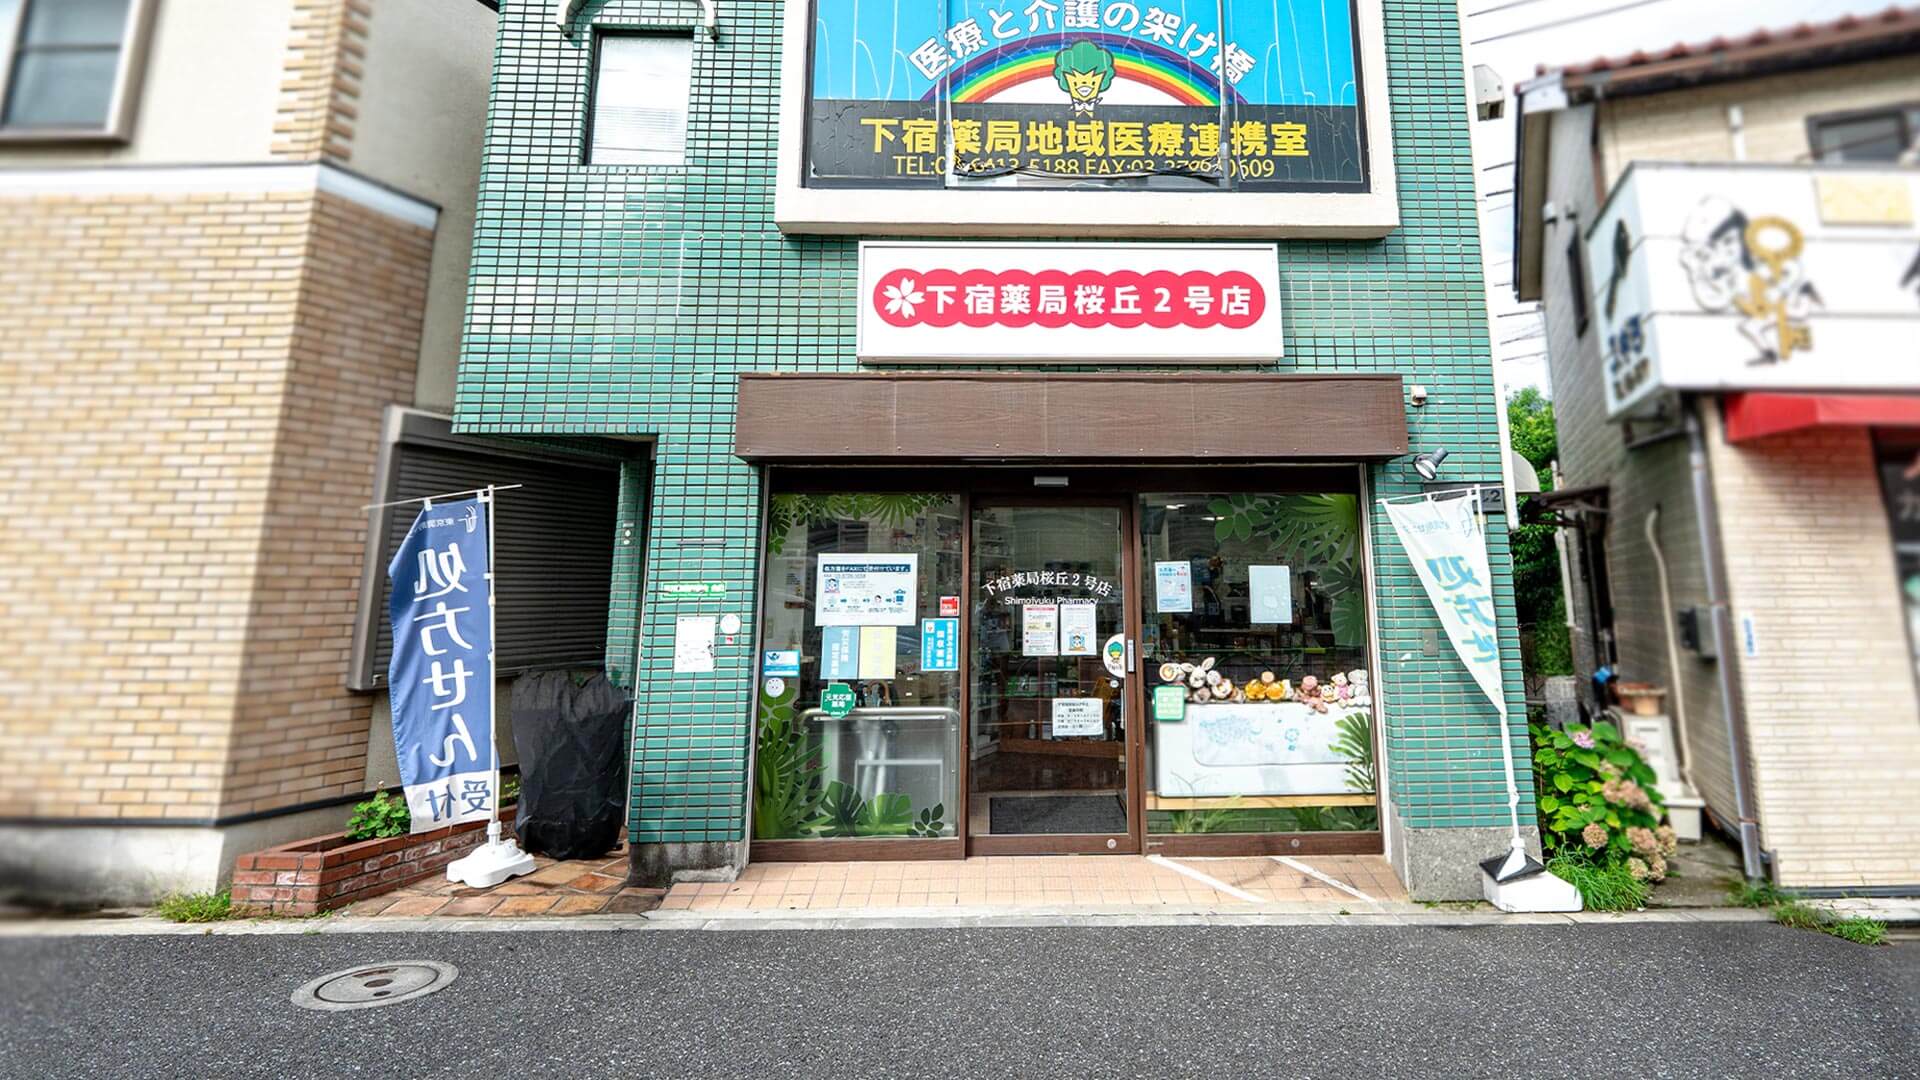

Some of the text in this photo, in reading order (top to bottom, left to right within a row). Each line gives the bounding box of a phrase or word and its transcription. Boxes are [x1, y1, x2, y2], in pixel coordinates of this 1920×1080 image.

[908, 0, 1257, 84] 医療と介護の架け橋
[860, 117, 1309, 158] 下宿薬局地域医療連携室
[926, 284, 1252, 316] 下宿薬局桜丘2号店
[981, 570, 1113, 597] 下宿薬局桜丘2号店
[1056, 597, 1099, 606] Pharmacy
